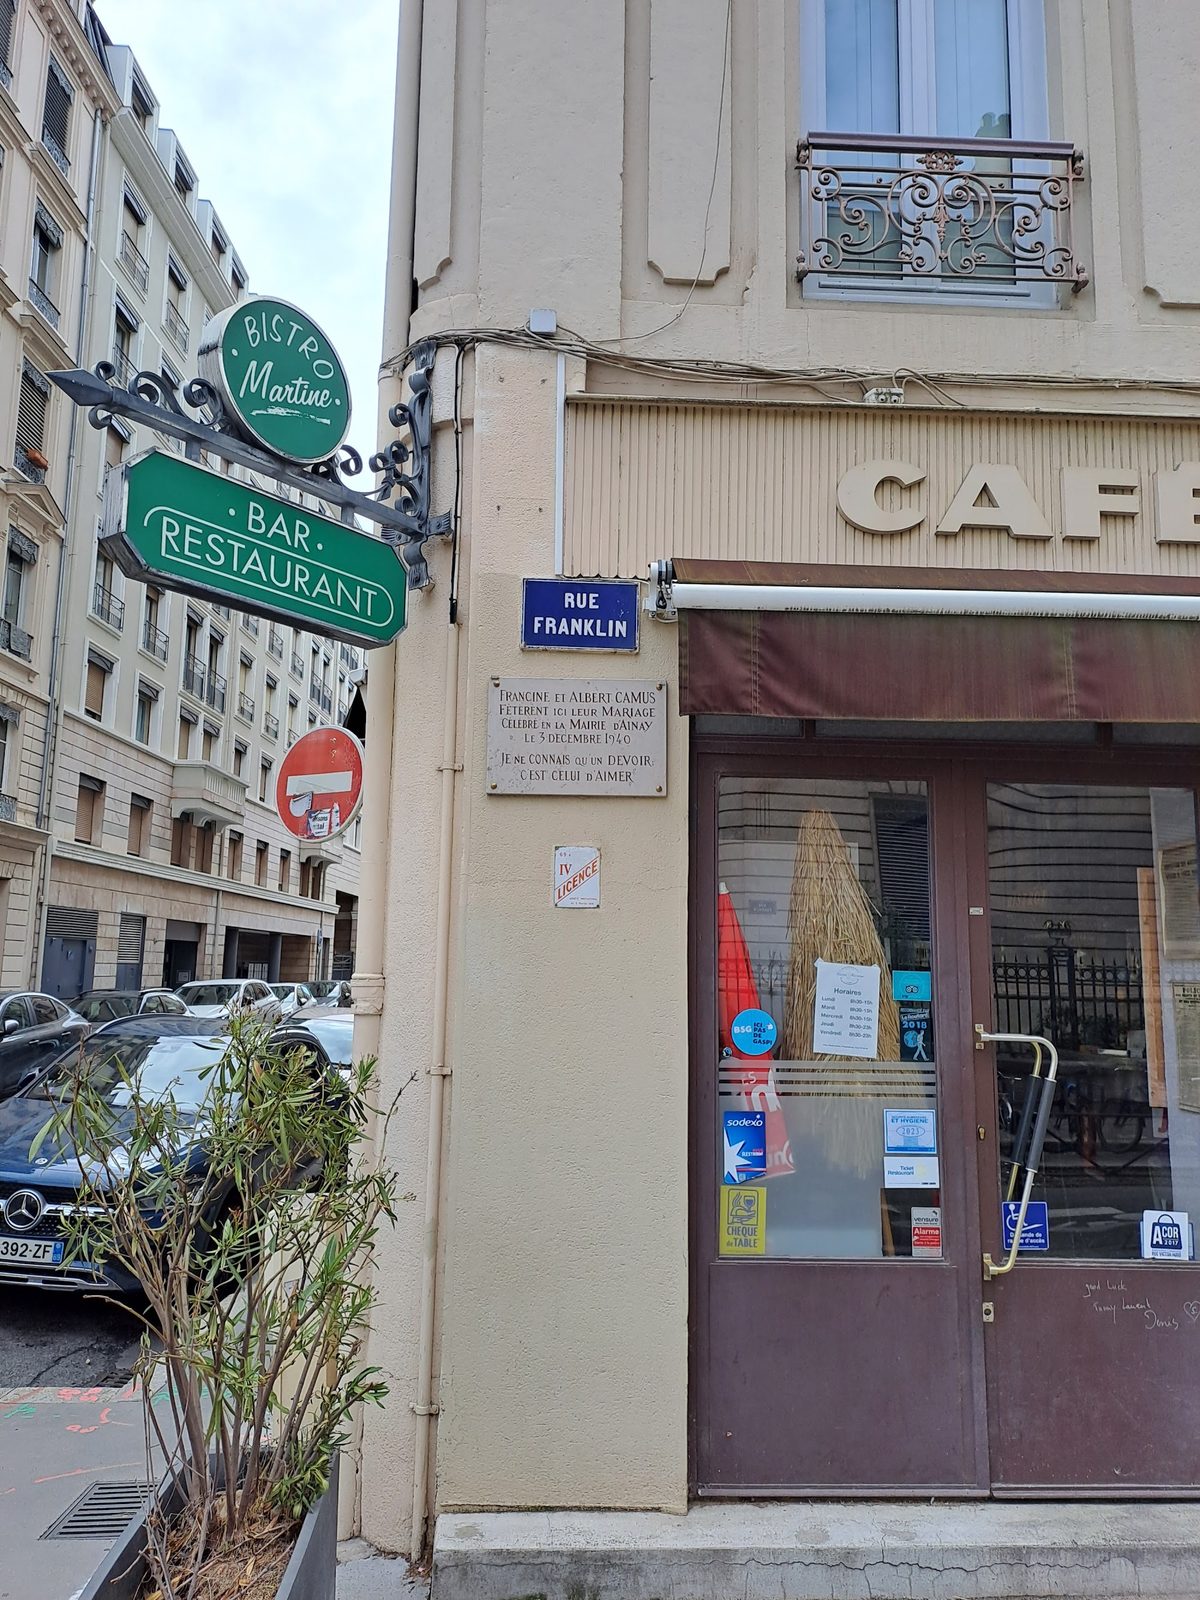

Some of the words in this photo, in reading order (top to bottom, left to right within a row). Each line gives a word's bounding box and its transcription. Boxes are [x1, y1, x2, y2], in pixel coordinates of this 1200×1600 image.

[244, 312, 334, 379] BISTRO
[239, 360, 332, 408] Martine
[247, 501, 310, 553] BAR
[161, 515, 378, 617] RESTAURANT
[564, 592, 599, 609] RUE
[533, 616, 627, 638] FRANKLIN
[500, 690, 549, 703] FRANCINE
[555, 693, 566, 703] ET
[569, 691, 613, 704] ALBERT
[615, 691, 656, 704] CAMUS
[553, 708, 567, 717] ICI
[571, 708, 598, 718] LEUR
[602, 705, 656, 719] MARIAGE
[555, 722, 566, 730] LA
[569, 719, 606, 730] MAIRIE
[524, 733, 535, 743] LE
[538, 732, 546, 744] 3
[605, 733, 631, 745] 1940
[500, 752, 511, 766] JE
[514, 756, 525, 765] NE
[528, 753, 571, 766] CONNAIS
[551, 770, 580, 782] CELUI
[559, 863, 572, 876] IV
[557, 860, 598, 900] LICENCE
[833, 987, 862, 996] Horaires
[733, 1025, 752, 1034] BSG
[902, 1021, 928, 1029] 2018
[726, 1115, 763, 1127] sodexo
[914, 1227, 940, 1235] Alarme
[733, 1237, 758, 1248] TABLE
